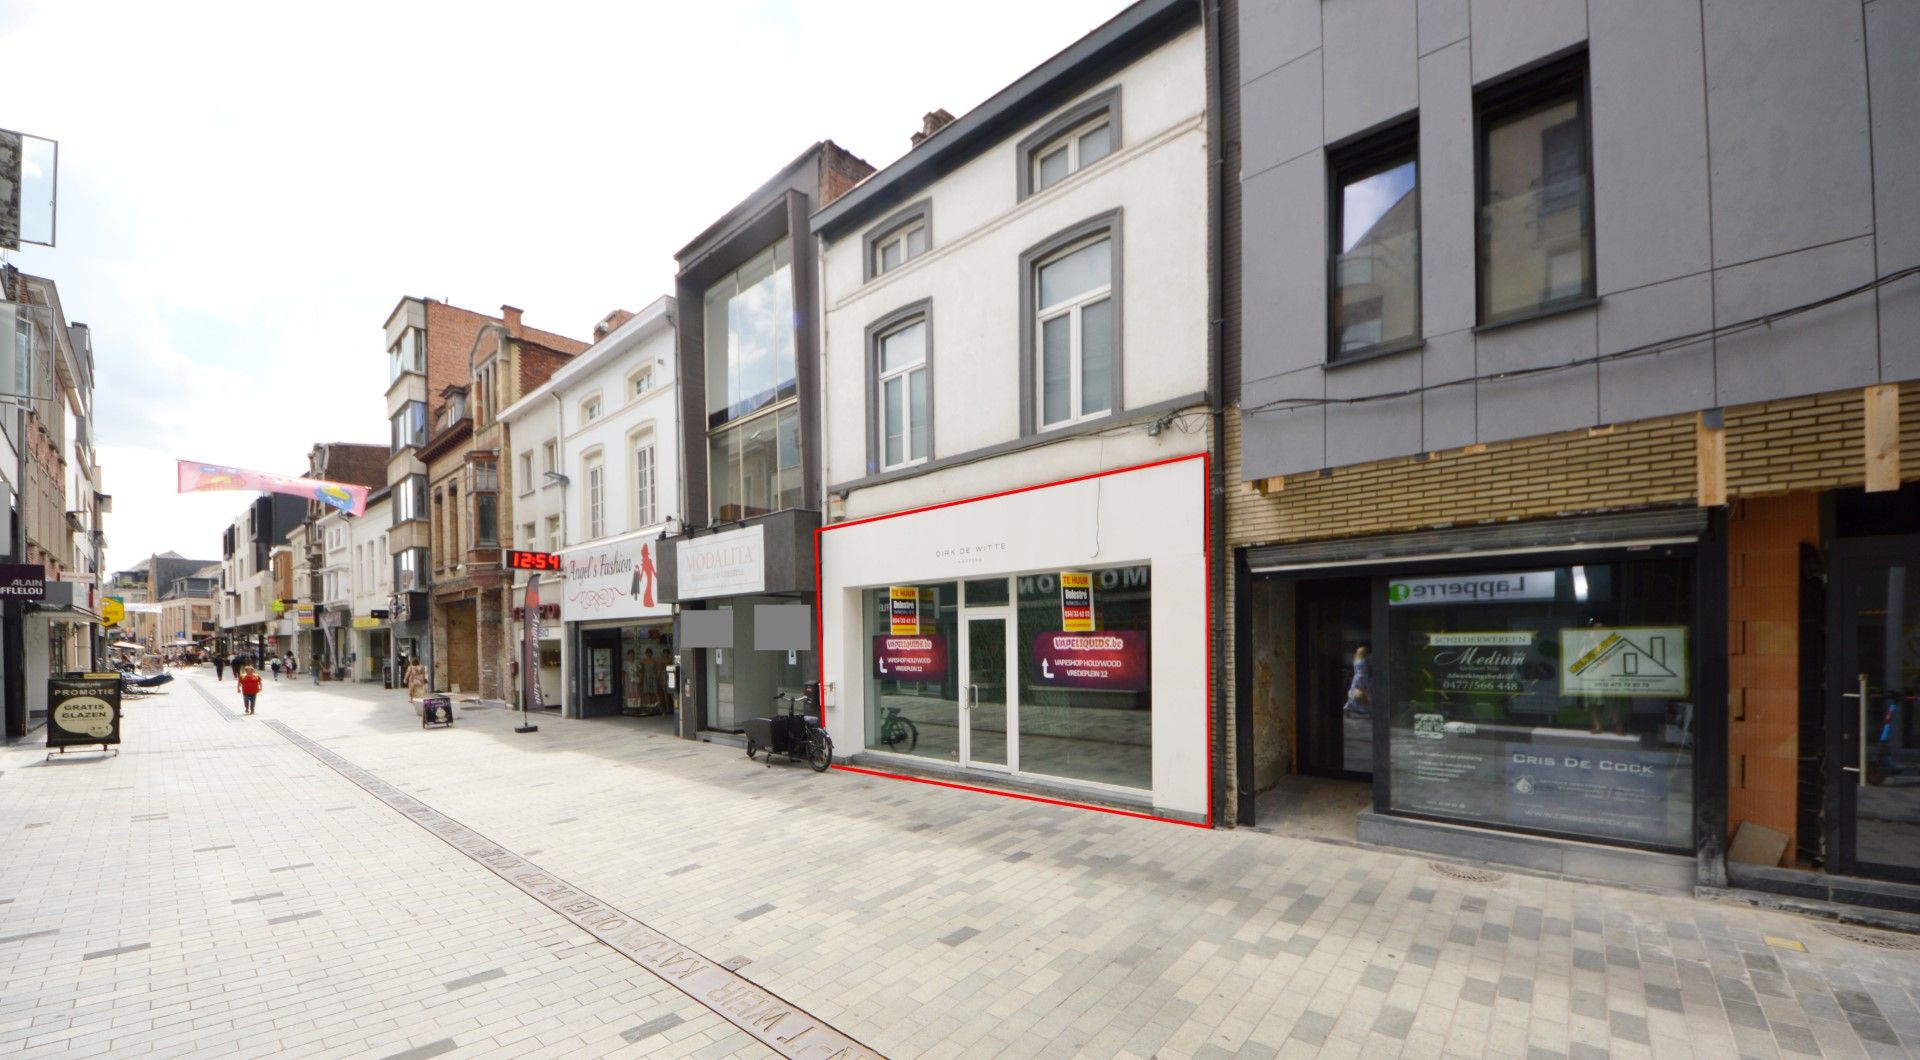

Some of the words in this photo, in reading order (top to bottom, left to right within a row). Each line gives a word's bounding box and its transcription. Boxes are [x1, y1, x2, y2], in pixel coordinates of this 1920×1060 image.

[935, 549, 956, 558] DIRK
[959, 547, 971, 555] DE
[975, 542, 1007, 552] WITTE
[513, 553, 559, 569] 12:54
[570, 559, 597, 587] Angel's
[600, 553, 632, 576] Fashion
[11, 578, 43, 588] ALAIN
[1072, 576, 1089, 584] HUUR
[1434, 635, 1527, 645] SCHILDERWERKEN
[1434, 647, 1526, 666] Medium
[1054, 659, 1083, 667] VAPESHOP
[1083, 659, 1122, 668] HOLLYWOOD
[1066, 669, 1100, 678] VREDEPLEIN
[1443, 681, 1494, 690] 0477/566
[1499, 682, 1518, 690] 448
[54, 688, 115, 696] PROMOTIE
[64, 703, 105, 711] GRATIS
[61, 711, 107, 719] GLAZEN
